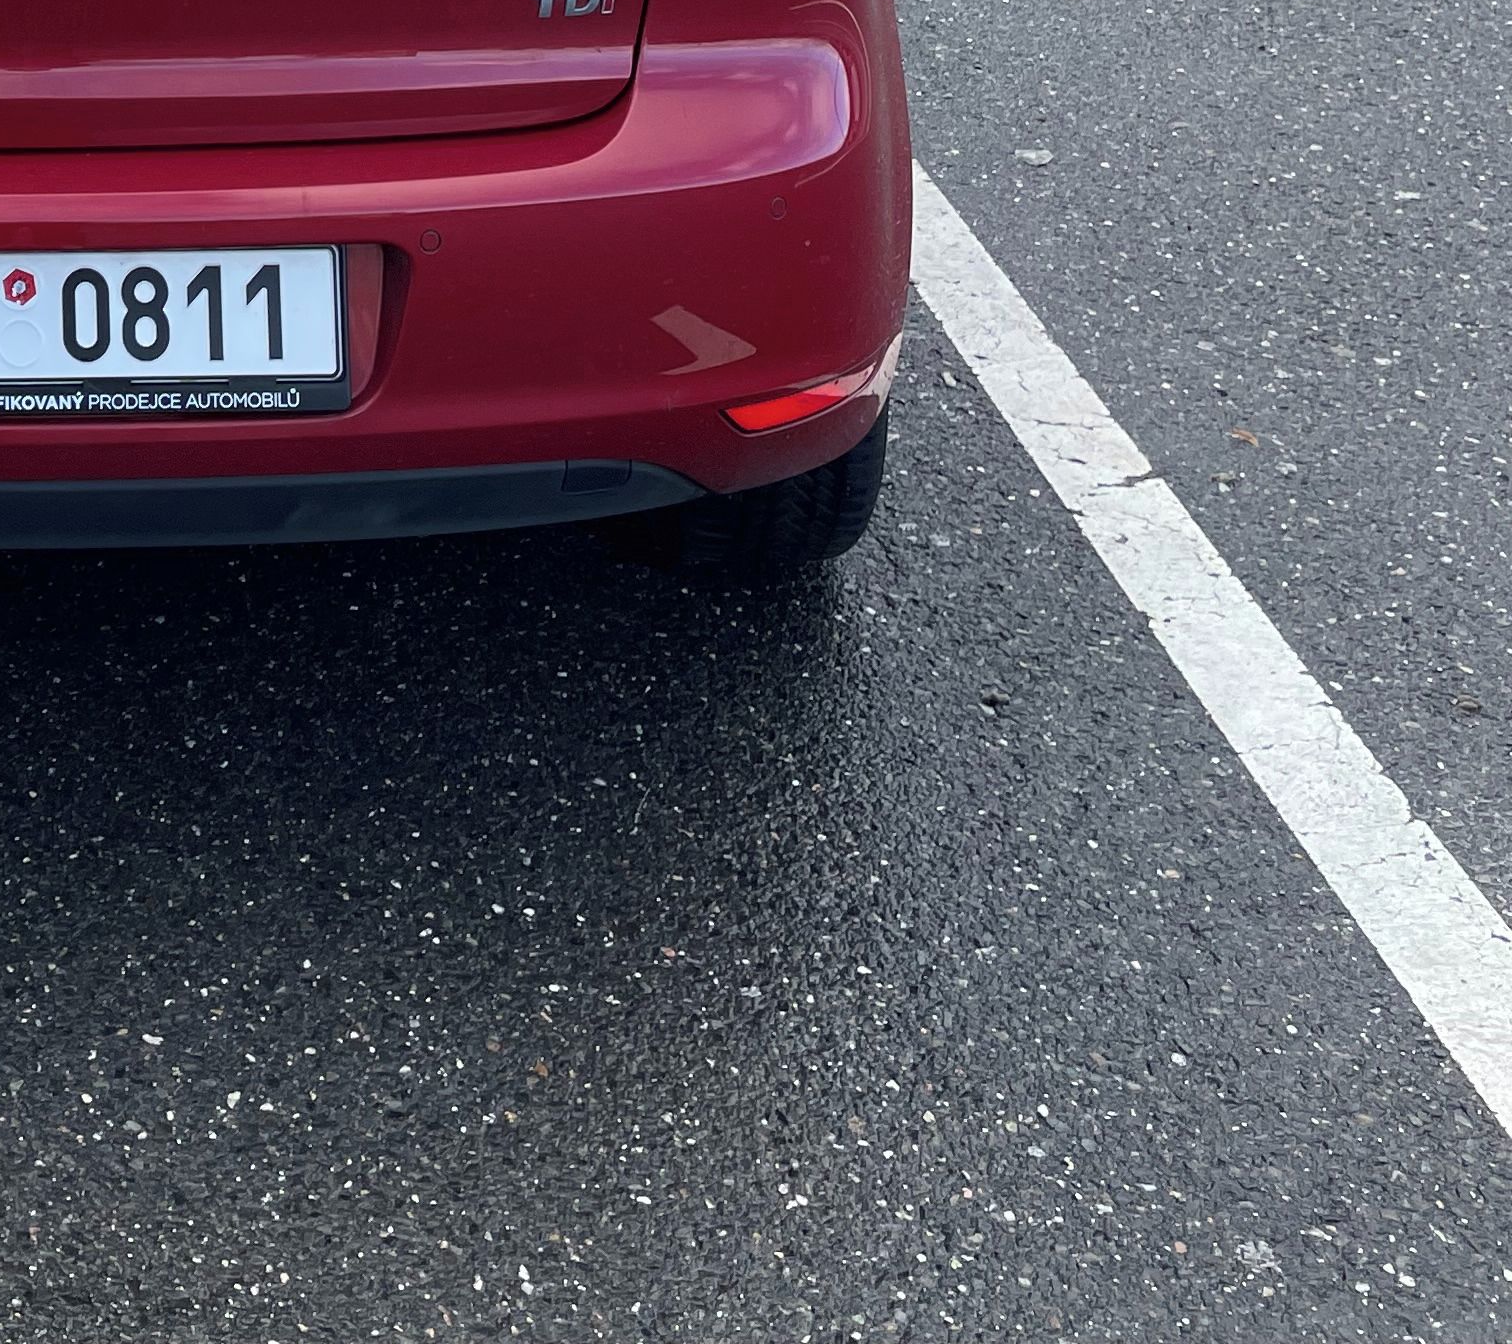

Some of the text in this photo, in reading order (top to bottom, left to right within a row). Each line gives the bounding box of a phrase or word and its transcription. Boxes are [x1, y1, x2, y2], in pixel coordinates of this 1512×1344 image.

[61, 264, 284, 363] 0811
[88, 394, 181, 409] PRODEJCE
[185, 388, 300, 409] AUTOMOBILŮ
